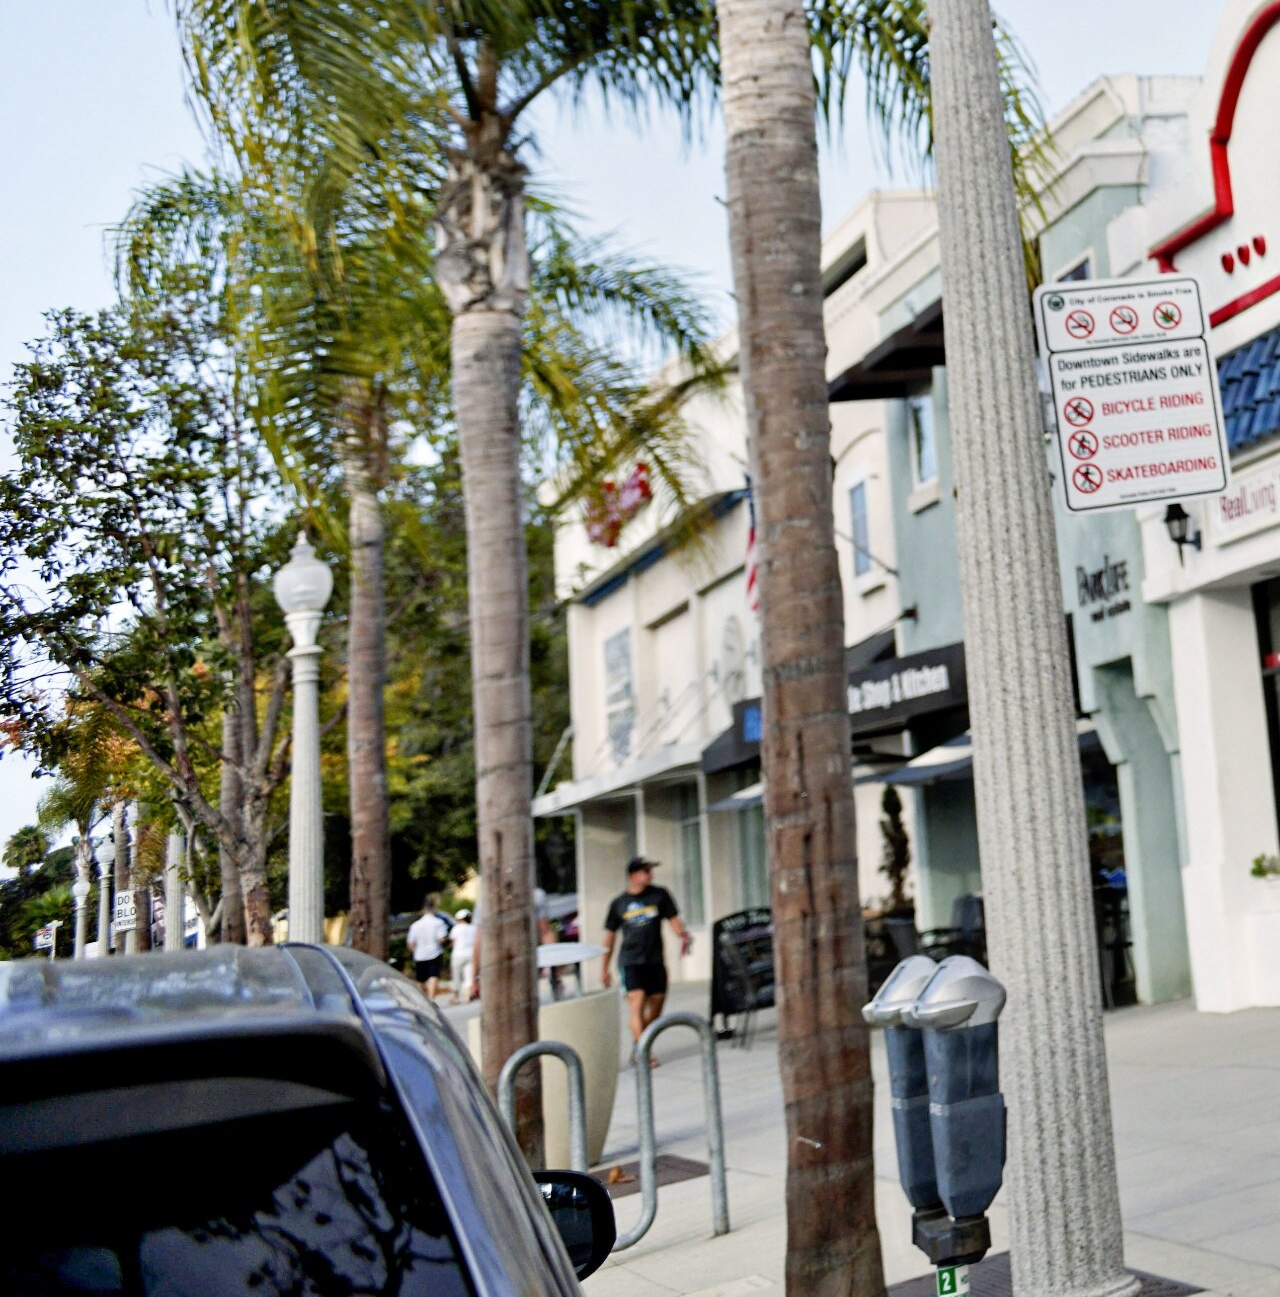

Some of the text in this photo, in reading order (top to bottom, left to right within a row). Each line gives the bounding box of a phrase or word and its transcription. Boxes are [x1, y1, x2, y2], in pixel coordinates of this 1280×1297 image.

[1057, 348, 1201, 372] Downtown Sidewalks are
[1061, 363, 1203, 391] for PEDESTRIANS ONLY
[1101, 392, 1205, 416] BICYCLE RIDING
[1102, 424, 1213, 449] SCOOTER RIDING
[1106, 457, 1218, 483] SKATEBOARDING
[117, 895, 130, 906] DO
[117, 907, 136, 918] BLO
[941, 1271, 952, 1292] 2
